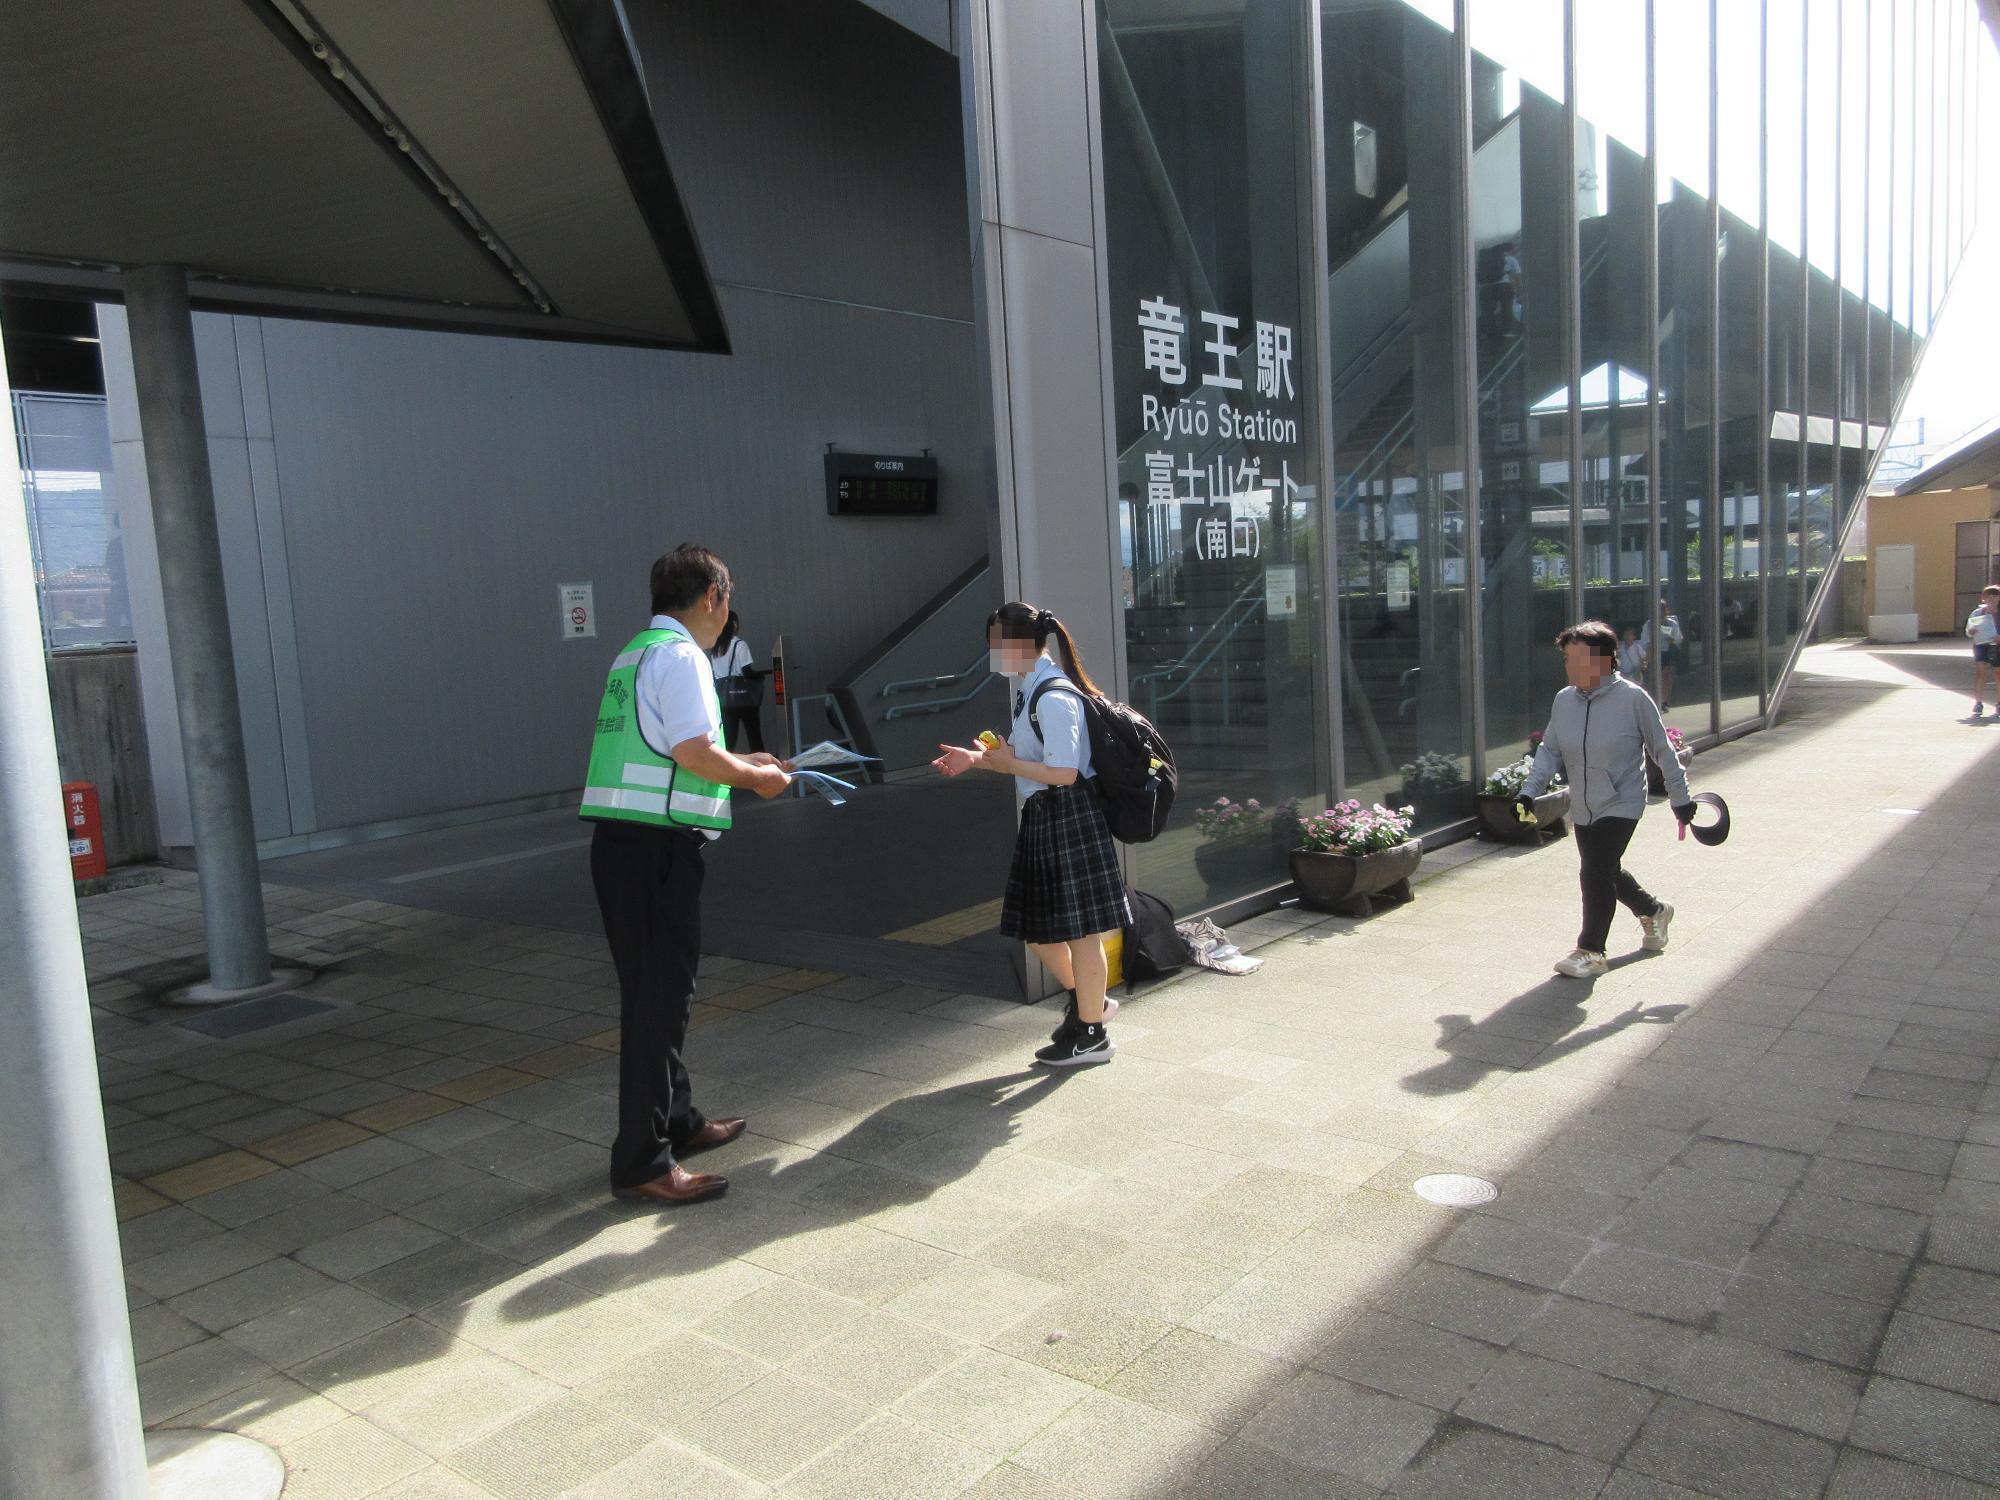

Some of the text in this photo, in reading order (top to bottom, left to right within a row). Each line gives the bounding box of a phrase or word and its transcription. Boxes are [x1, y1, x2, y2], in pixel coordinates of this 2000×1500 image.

[1138, 295, 1295, 401] 竜王駅
[1142, 394, 1297, 444] Ryūō Station
[1145, 449, 1299, 507] 富士山ゲート
[1195, 517, 1261, 561] (南口)
[71, 793, 86, 826] 消火器
[1088, 1025, 1095, 1035] C
